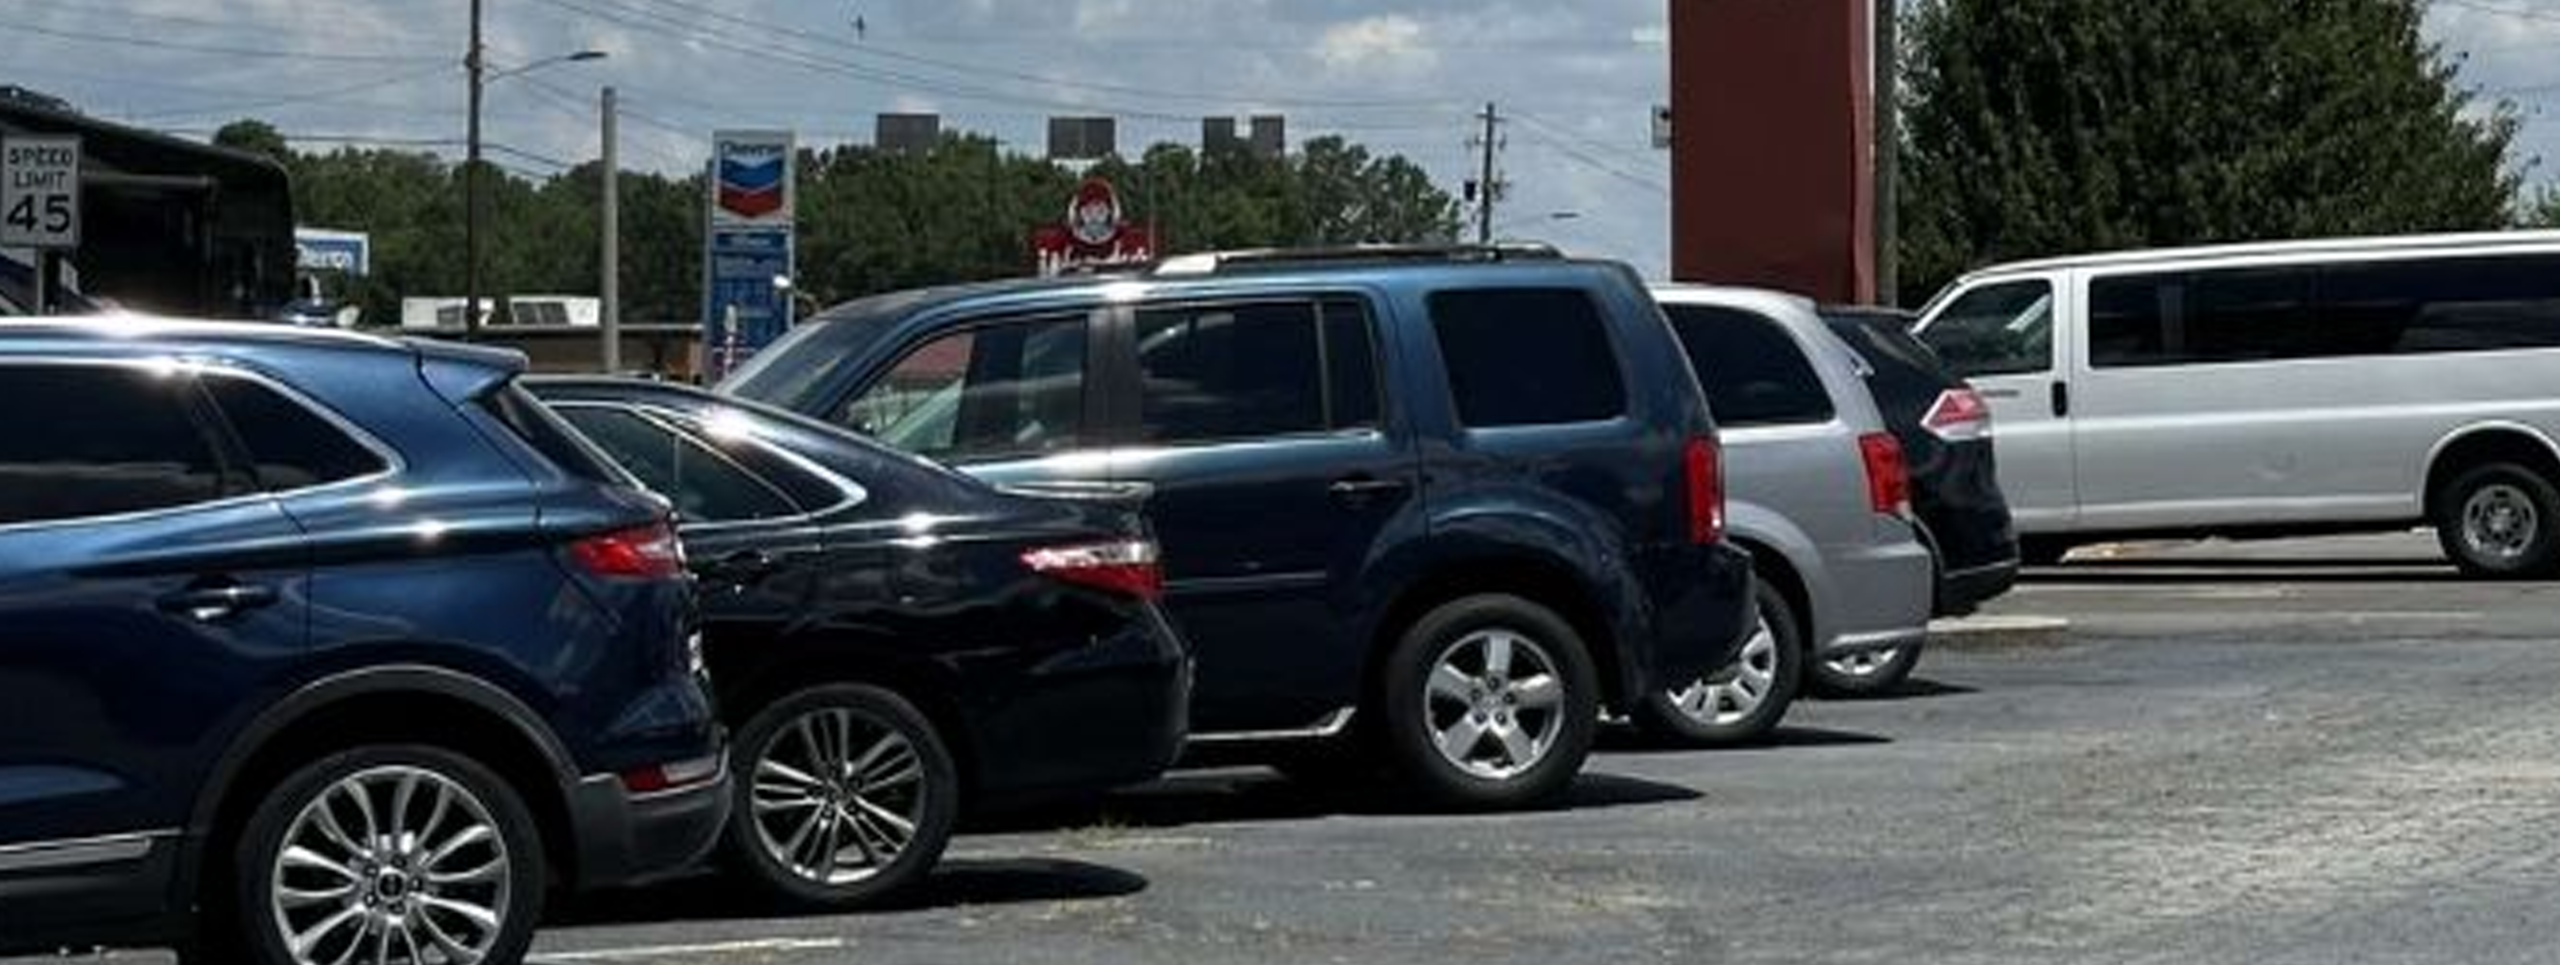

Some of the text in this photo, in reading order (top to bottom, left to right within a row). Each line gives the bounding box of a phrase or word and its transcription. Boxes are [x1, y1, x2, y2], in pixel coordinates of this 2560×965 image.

[9, 147, 73, 165] SPEED
[15, 171, 66, 189] LIMIT
[7, 195, 71, 233] 45
